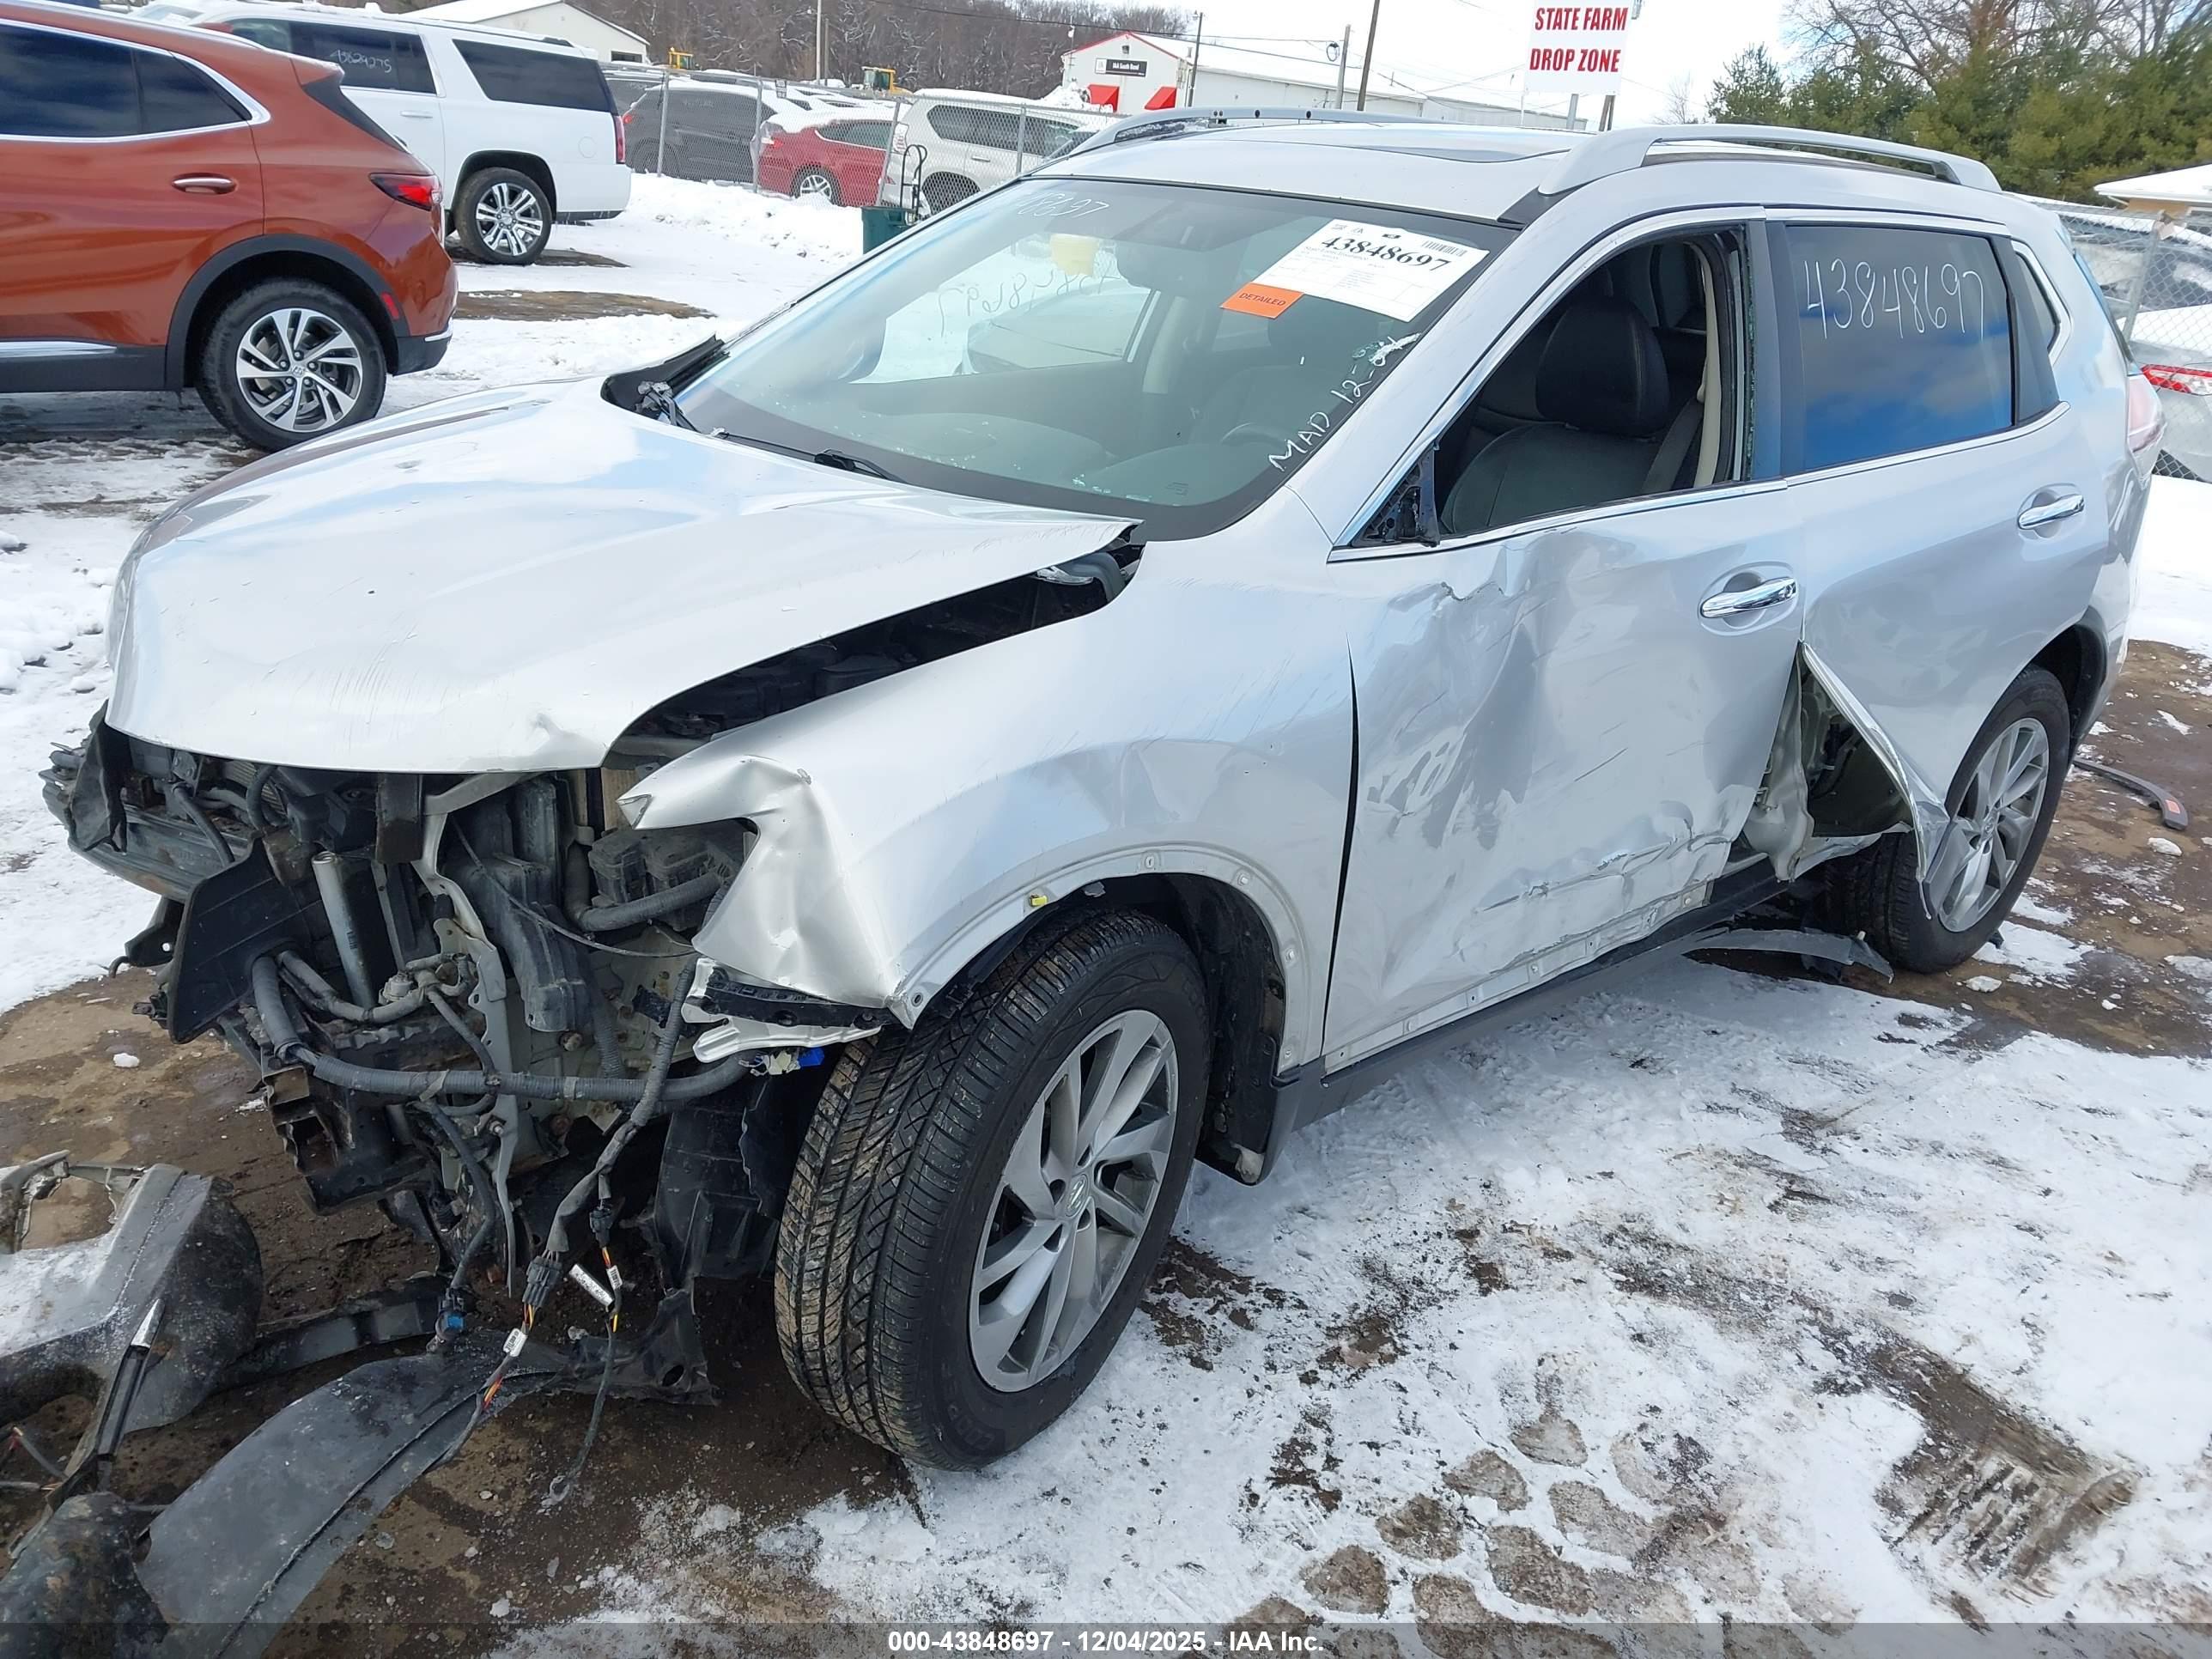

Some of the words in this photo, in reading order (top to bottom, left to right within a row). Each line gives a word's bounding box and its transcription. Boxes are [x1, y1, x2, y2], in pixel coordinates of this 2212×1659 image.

[1534, 7, 1580, 31] STATE
[1583, 7, 1628, 31] FARM
[1529, 48, 1576, 71] DROP
[1577, 48, 1621, 72] ZONE
[1321, 235, 1452, 271] 43848697
[1239, 292, 1286, 307] DETAILED
[1804, 258, 1984, 341] 43848697
[1268, 411, 1330, 471] MAD
